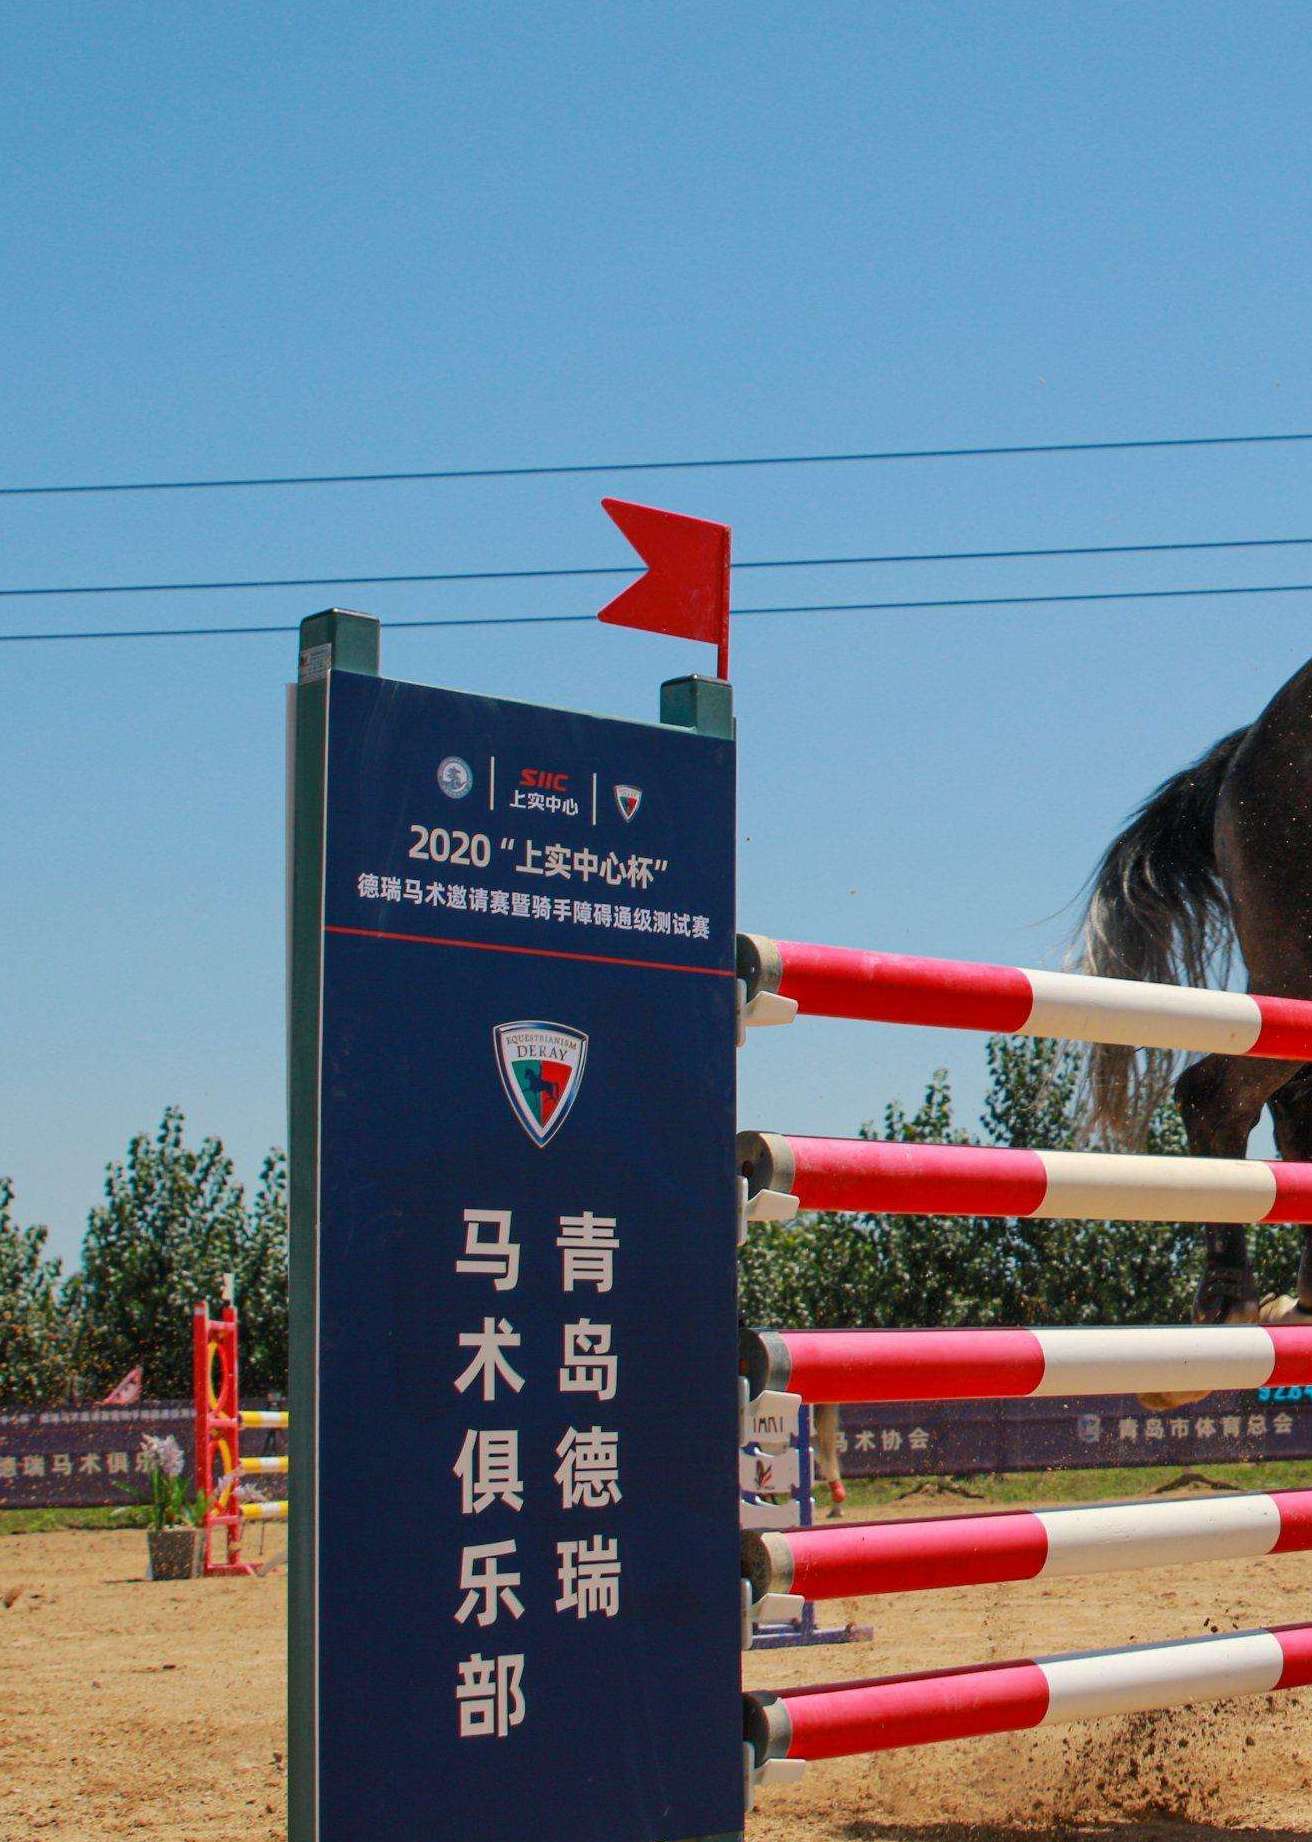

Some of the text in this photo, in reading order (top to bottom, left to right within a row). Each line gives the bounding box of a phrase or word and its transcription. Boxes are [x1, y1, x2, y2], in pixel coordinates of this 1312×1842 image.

[519, 769, 568, 792] SIIC
[509, 789, 579, 816] 上实中心
[357, 872, 710, 940] 德瑞马术邀请赛暨骑手障碍通级测试赛
[506, 1033, 577, 1050] EQUESTRIANISM
[516, 1044, 568, 1060] DERAY
[553, 1210, 622, 1619] 青岛德瑞
[453, 1208, 525, 1738] 马术俱乐部
